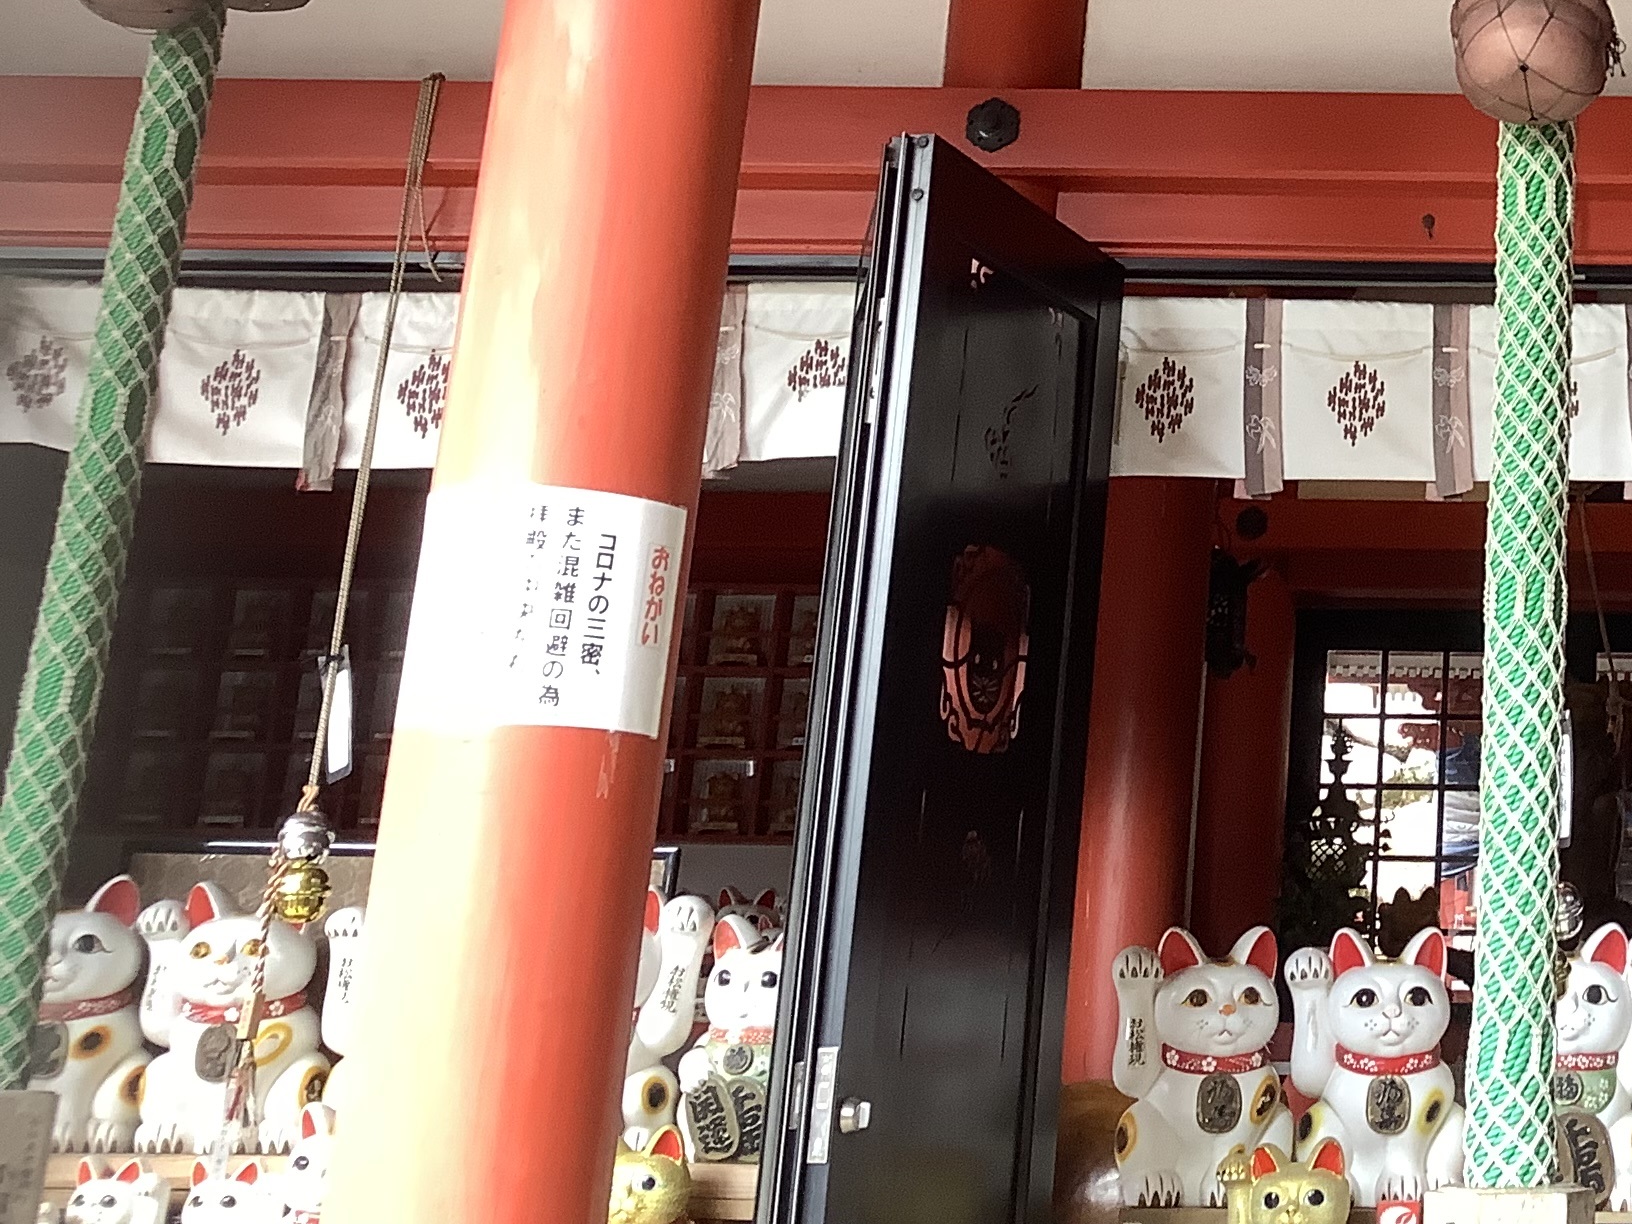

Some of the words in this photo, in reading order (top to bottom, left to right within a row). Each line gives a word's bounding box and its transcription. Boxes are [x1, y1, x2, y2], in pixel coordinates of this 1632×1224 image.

[538, 506, 586, 708] また混雑回避の為
